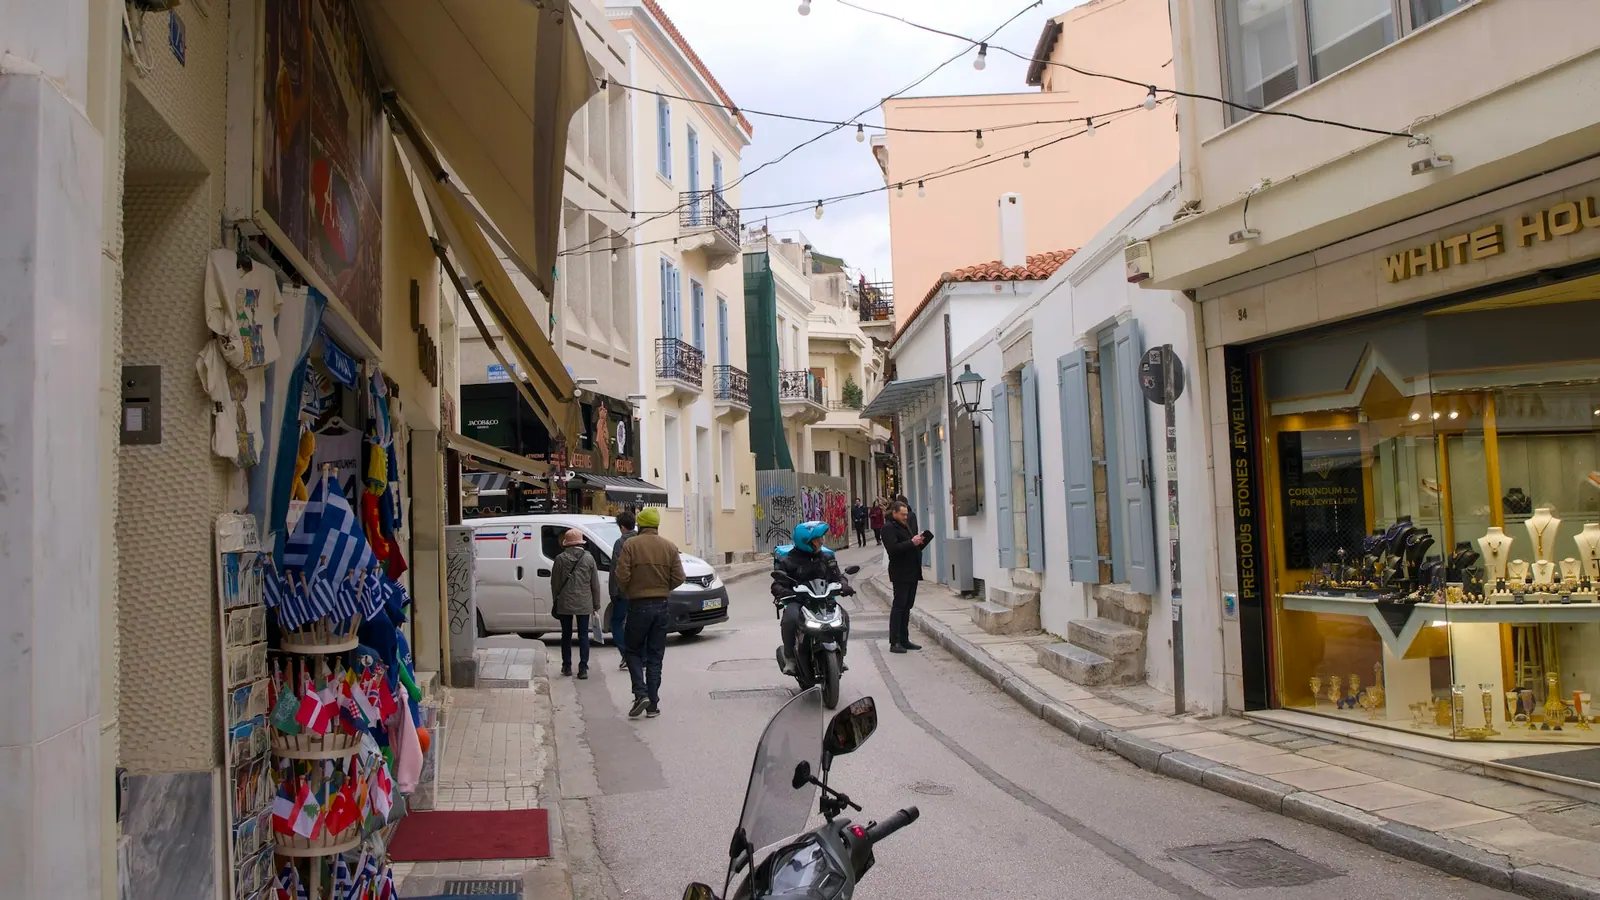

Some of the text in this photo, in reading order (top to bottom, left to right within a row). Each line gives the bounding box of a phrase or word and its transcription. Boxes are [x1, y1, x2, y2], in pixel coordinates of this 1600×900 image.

[1383, 224, 1505, 284] WHITE
[1230, 365, 1255, 599] PRECIOUS STONES JEWELLERY
[1288, 487, 1342, 497] CORUNDUM
